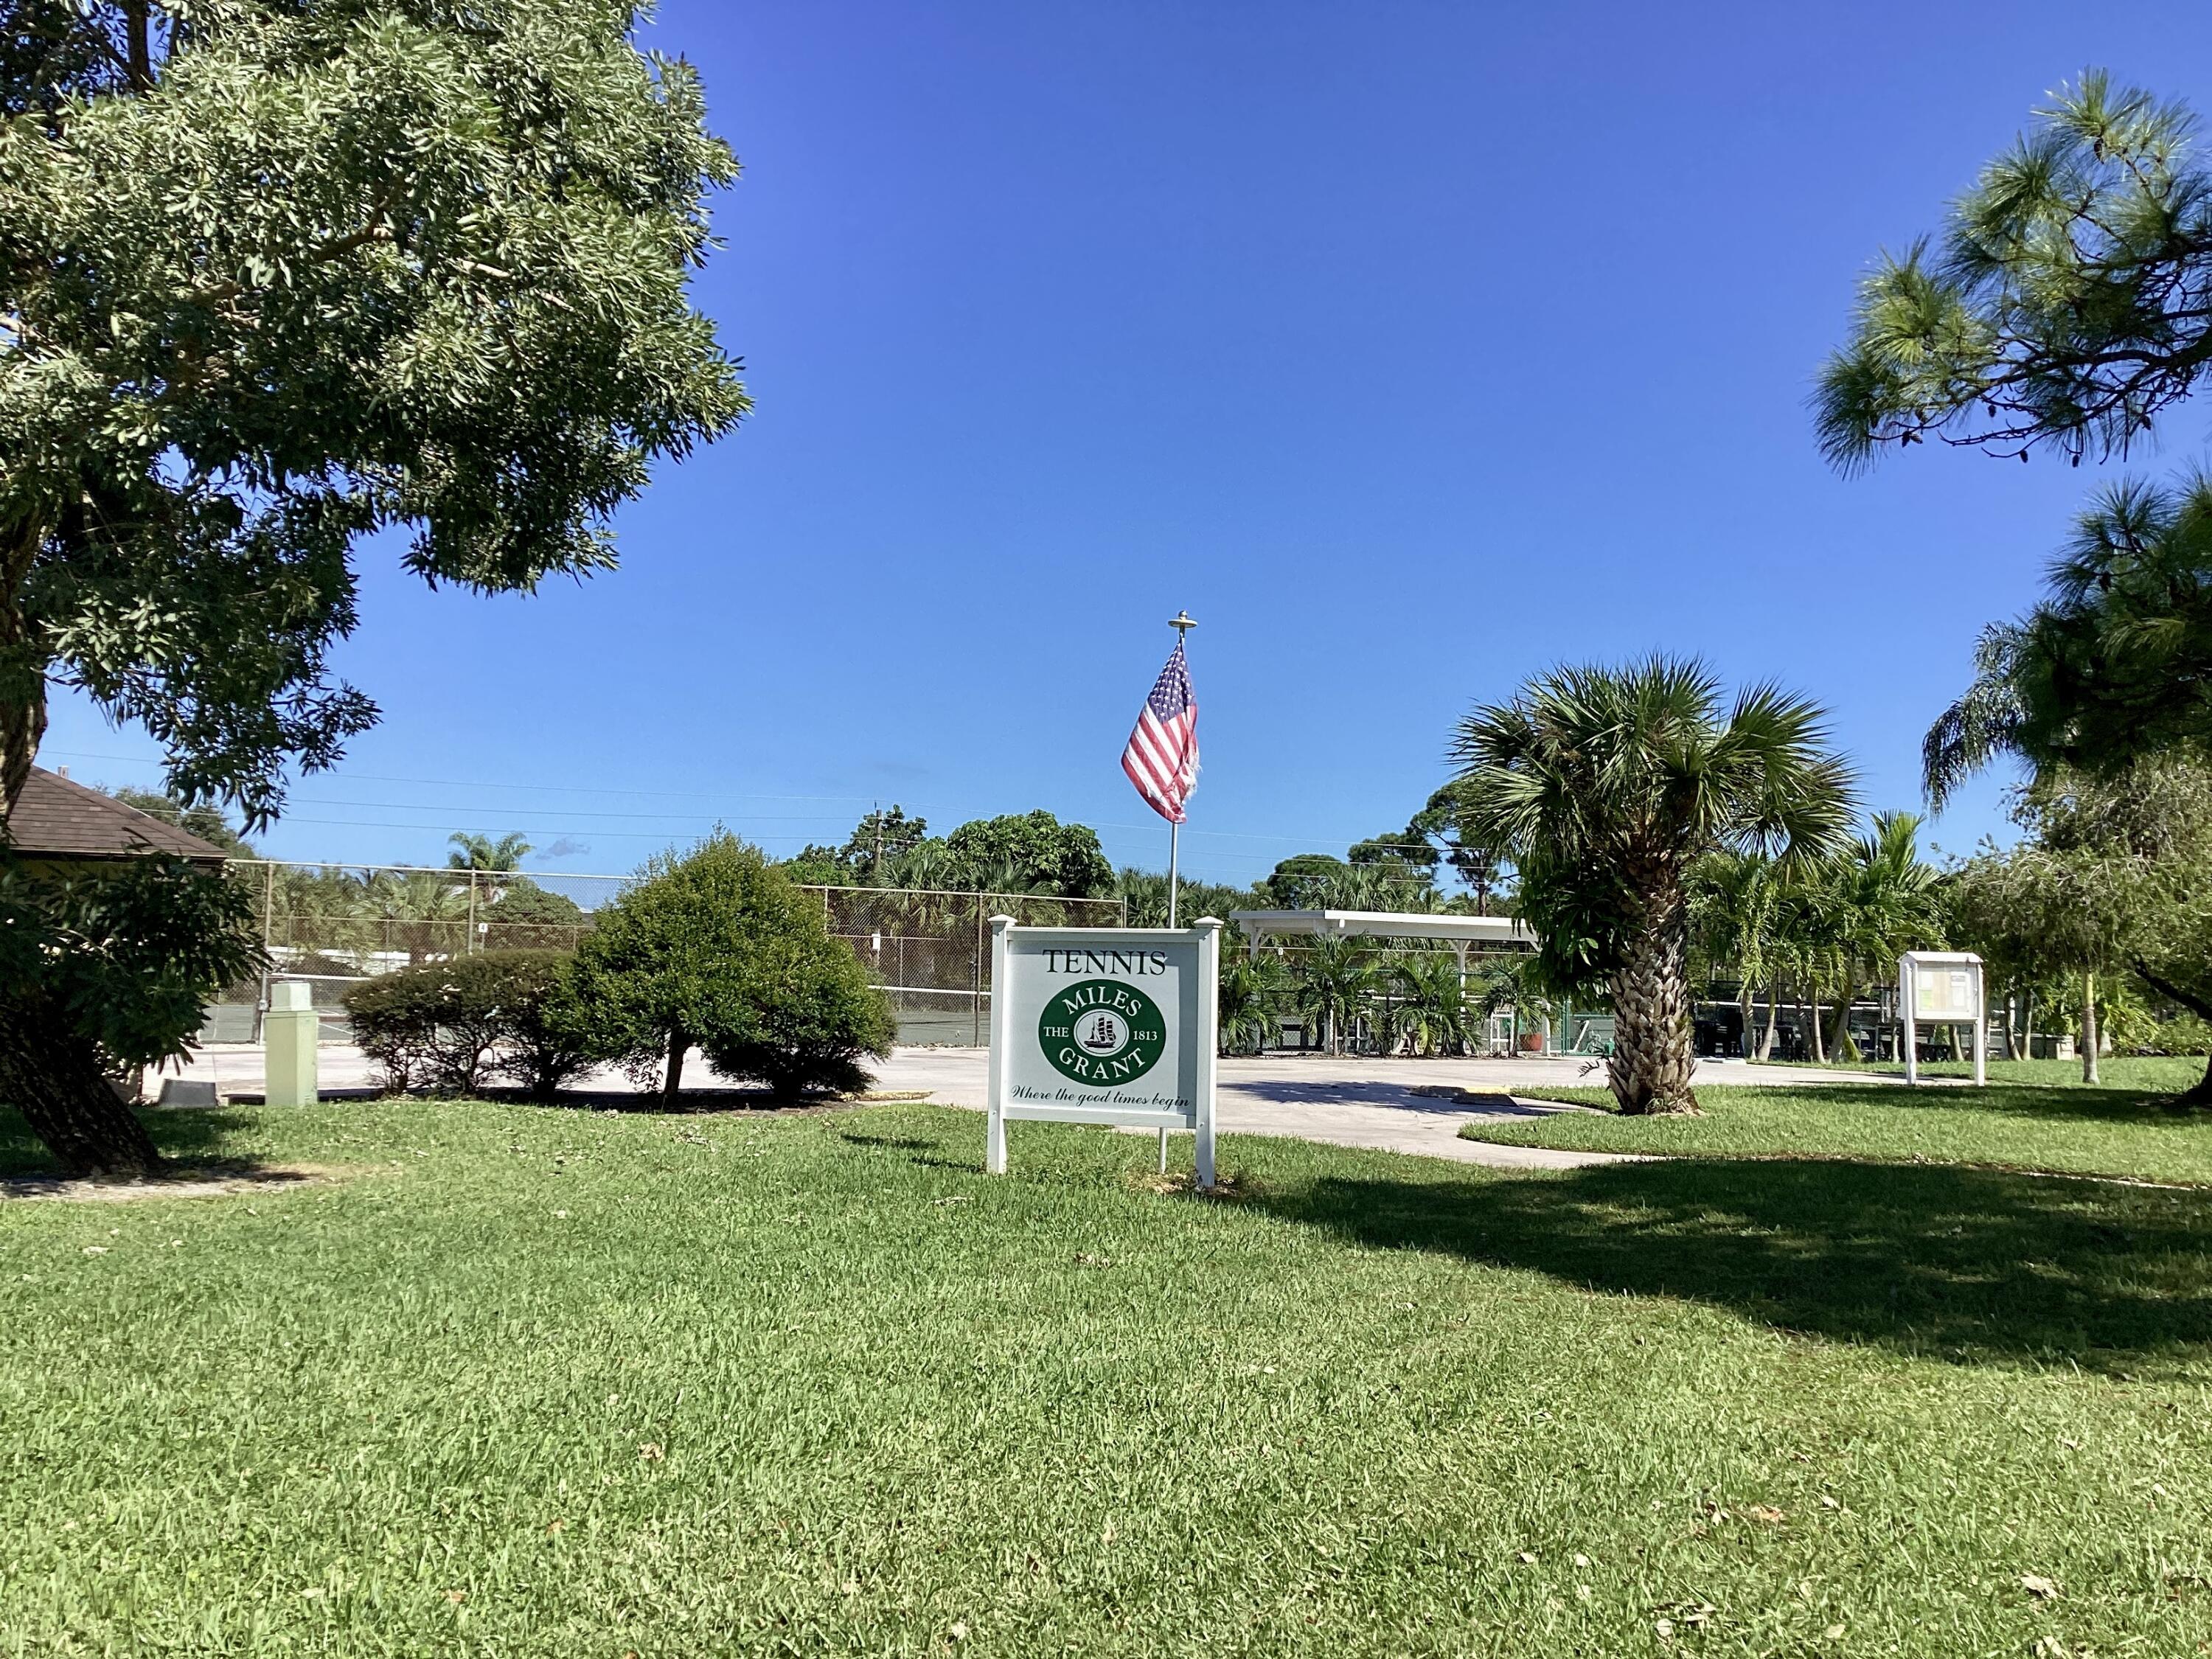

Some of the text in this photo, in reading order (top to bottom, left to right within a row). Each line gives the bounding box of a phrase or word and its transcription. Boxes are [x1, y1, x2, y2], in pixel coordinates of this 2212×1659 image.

[1042, 949, 1167, 975] TENNIS
[1062, 986, 1142, 1017] MILES
[1043, 1026, 1069, 1037] THE
[1133, 1030, 1158, 1041] 1813
[1059, 1047, 1146, 1079] GRANT
[1011, 1085, 1190, 1111] Where the good times begin
